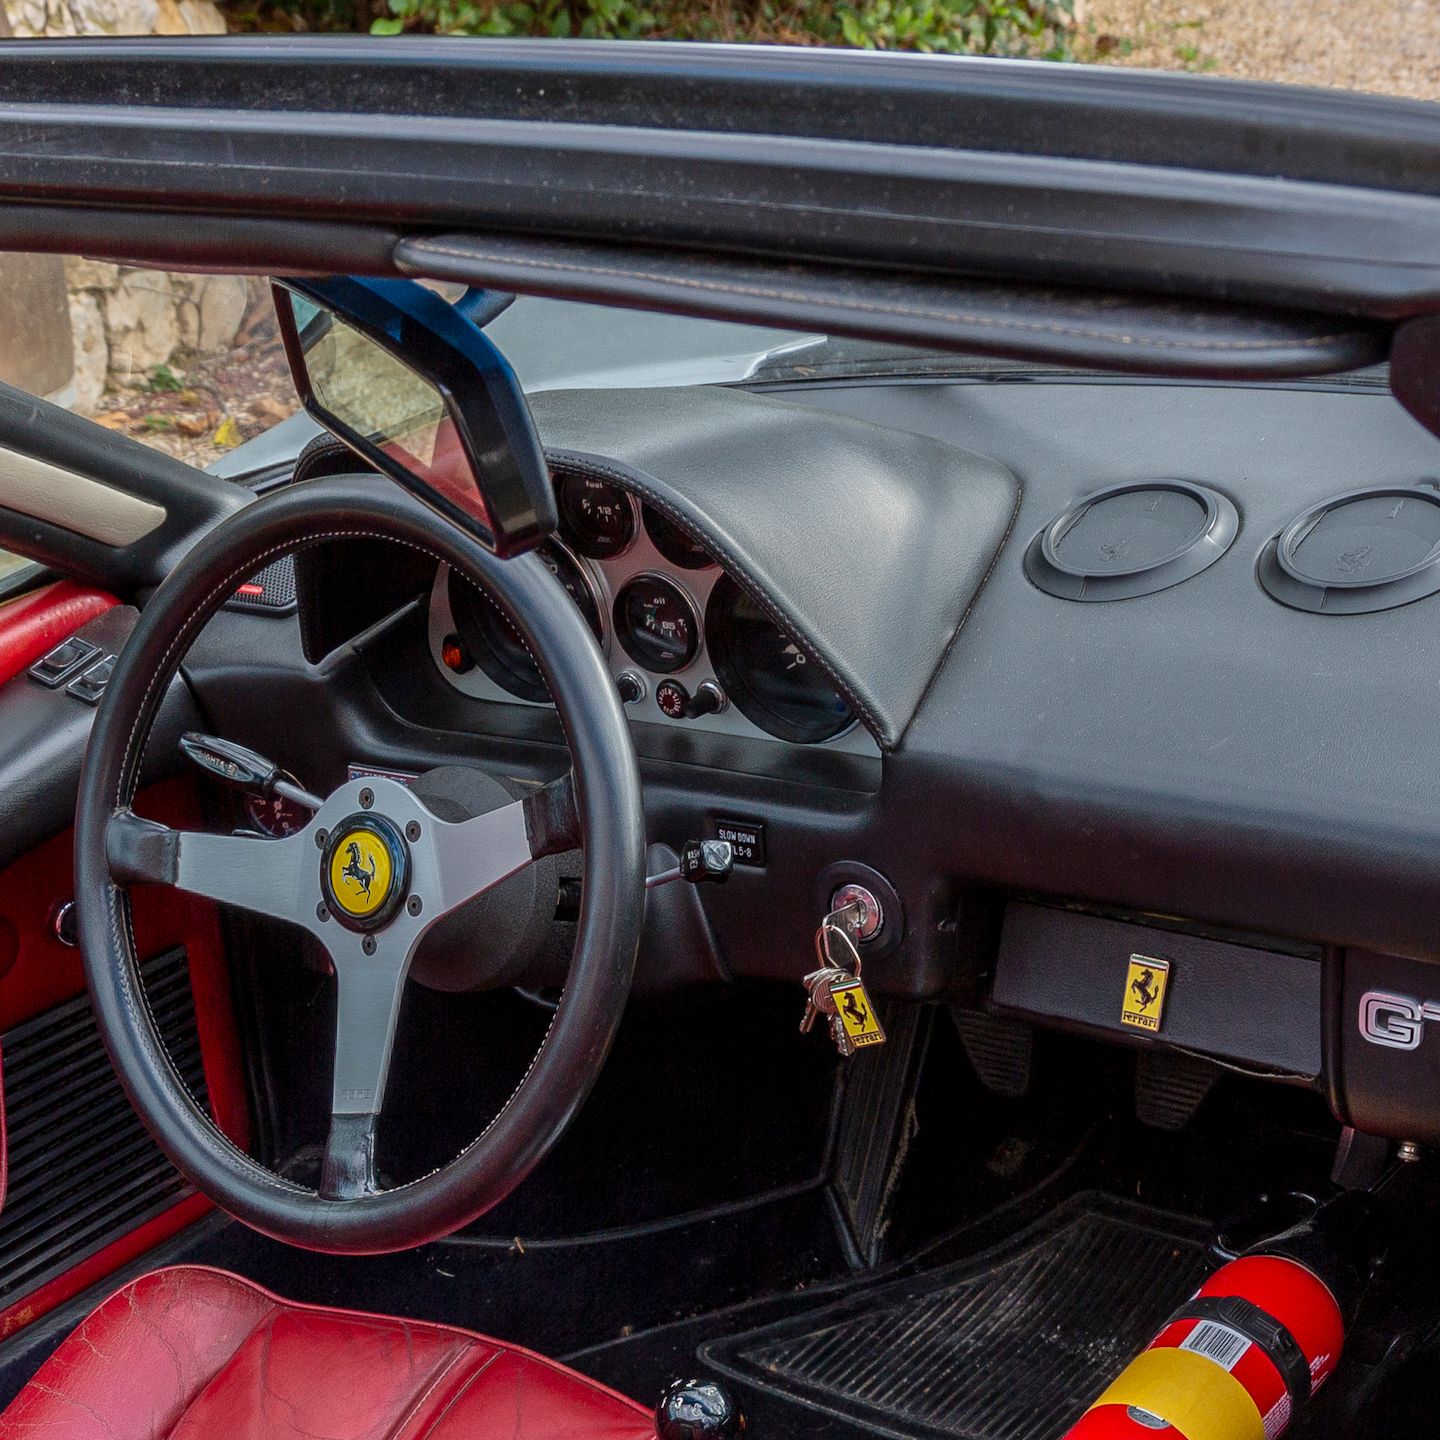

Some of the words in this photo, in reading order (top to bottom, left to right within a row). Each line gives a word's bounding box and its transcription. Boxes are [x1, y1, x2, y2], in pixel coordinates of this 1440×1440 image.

[585, 480, 603, 489] fuel
[718, 829, 736, 841] SLOW
[737, 832, 756, 844] DOWN
